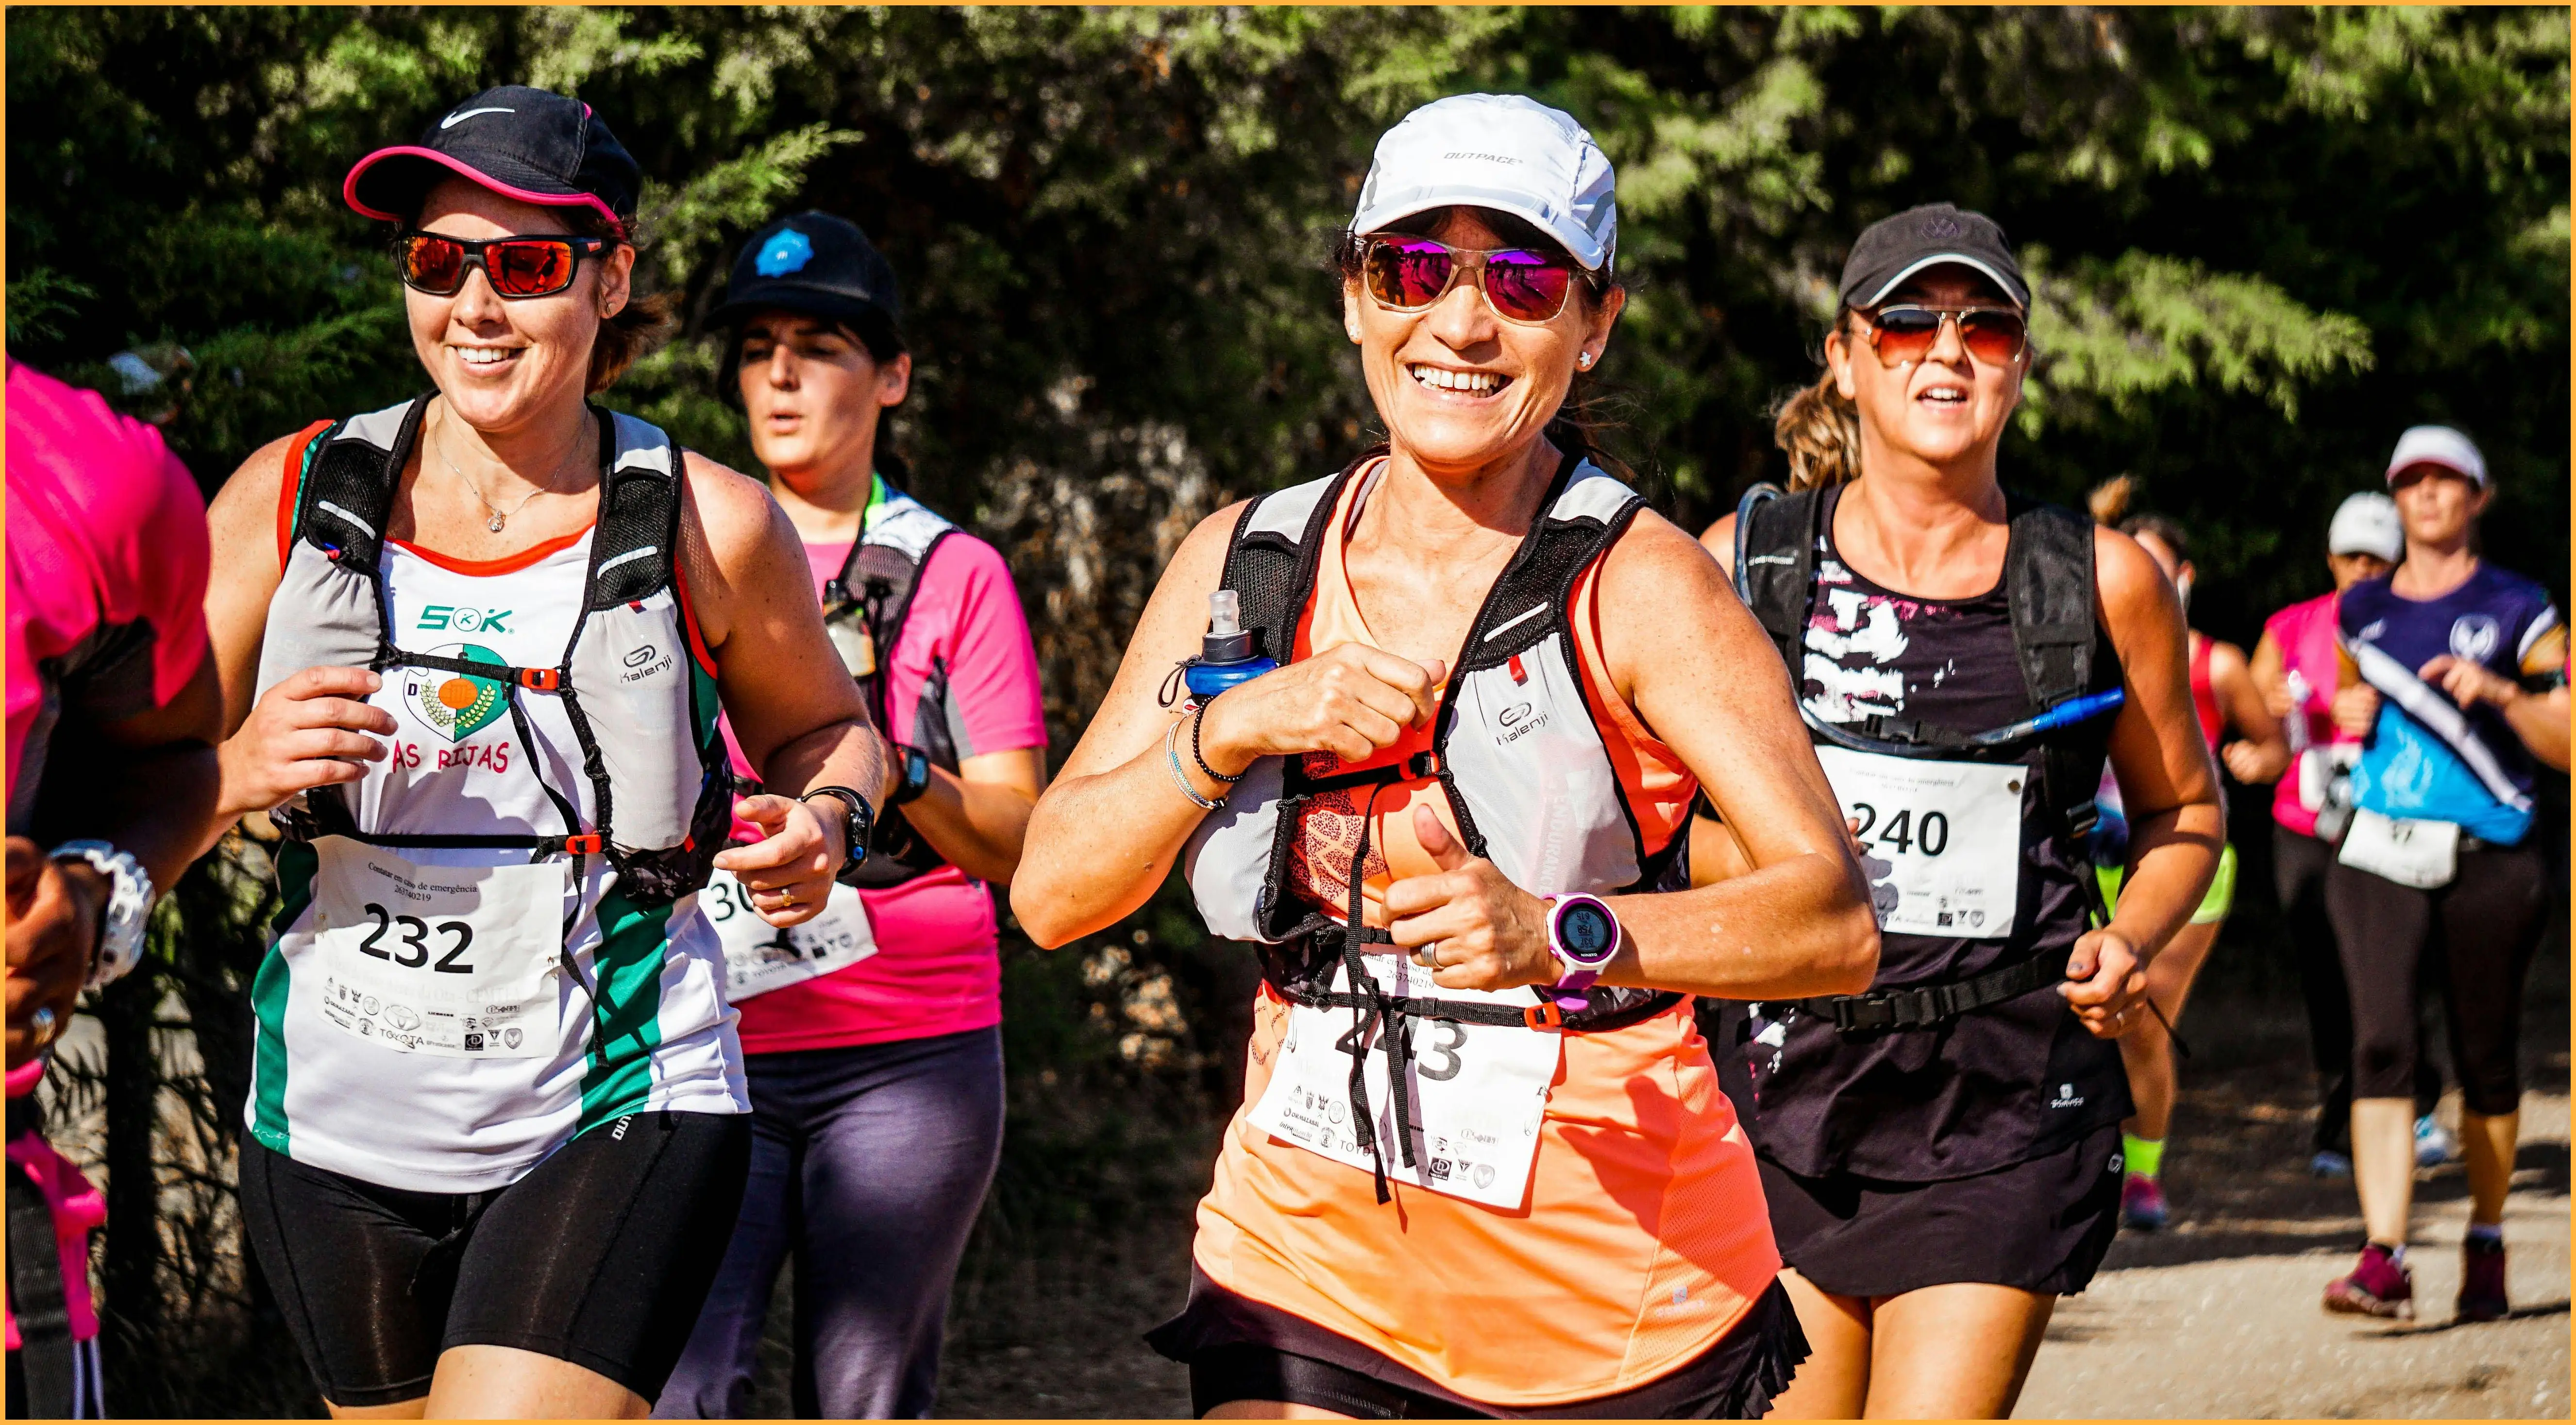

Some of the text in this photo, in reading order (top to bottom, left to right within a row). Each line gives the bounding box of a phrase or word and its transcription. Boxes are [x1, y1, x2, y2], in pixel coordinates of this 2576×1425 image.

[620, 655, 672, 683] Kalenji
[1496, 711, 1548, 746] Kalenji
[438, 742, 509, 773] RIJAS
[1852, 802, 1949, 857] 240
[418, 882, 428, 891] de
[430, 884, 478, 895] emergência
[359, 902, 473, 974] 232
[1359, 950, 1385, 963] ontatar
[1386, 958, 1399, 967] em
[1401, 963, 1420, 973] caso
[1386, 969, 1435, 989] 263740219
[379, 1028, 424, 1045] TOYOTA
[1340, 1139, 1385, 1162] TOYO
